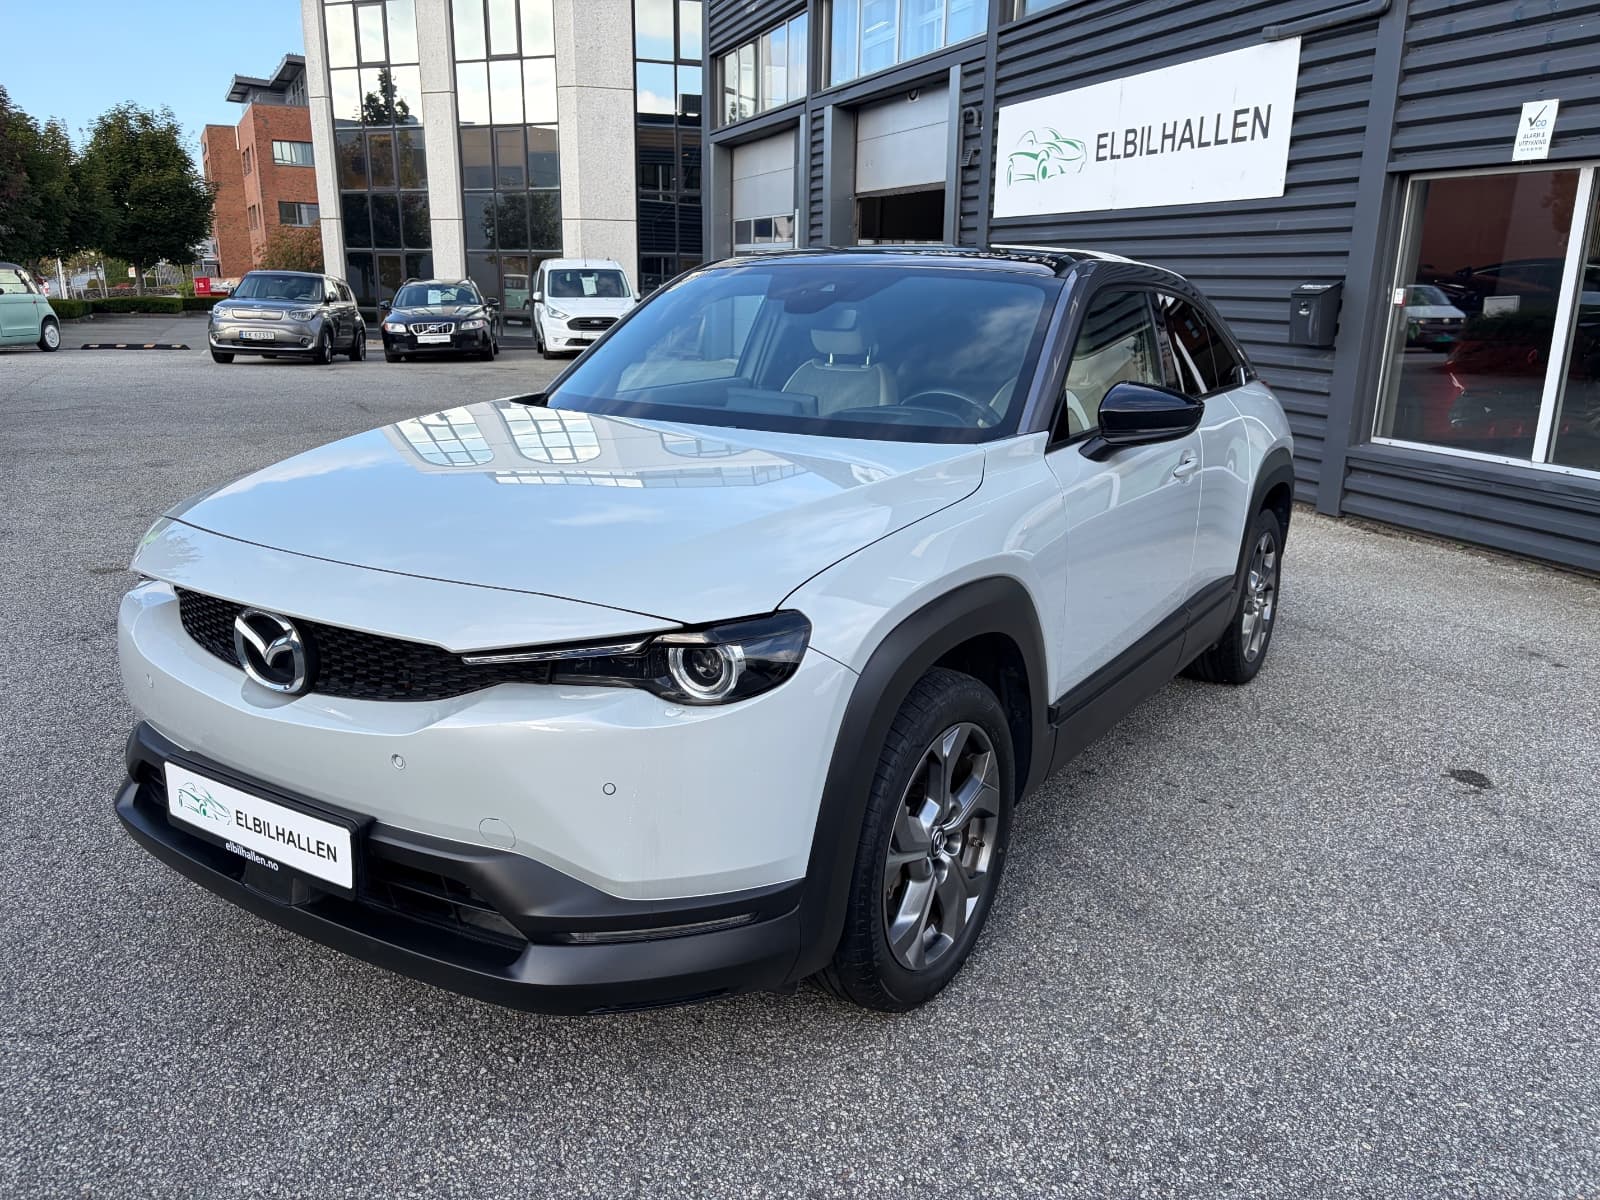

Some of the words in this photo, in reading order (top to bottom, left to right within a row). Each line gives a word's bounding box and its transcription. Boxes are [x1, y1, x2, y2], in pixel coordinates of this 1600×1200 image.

[1095, 104, 1272, 162] ELBILHALLEN
[225, 841, 279, 871] elbilhallen.no
[235, 809, 338, 863] ELBILHALLEN
